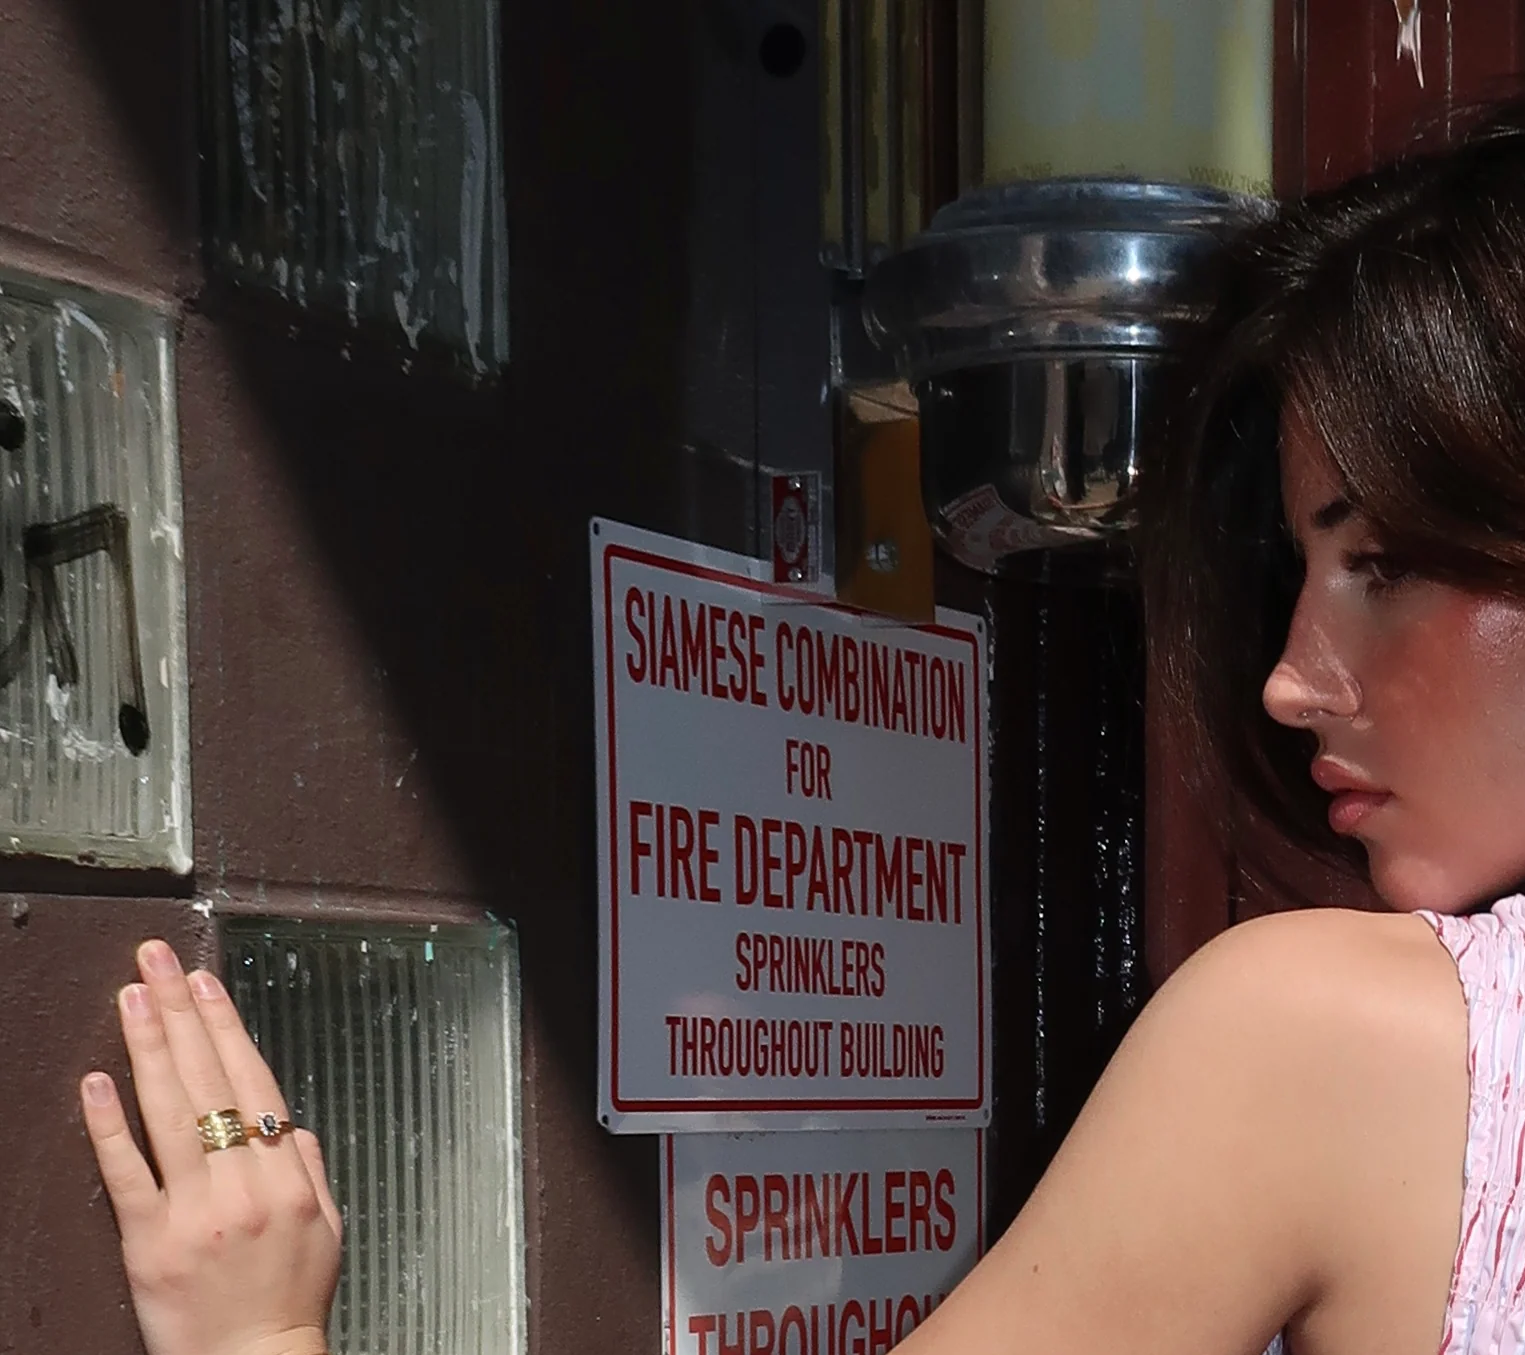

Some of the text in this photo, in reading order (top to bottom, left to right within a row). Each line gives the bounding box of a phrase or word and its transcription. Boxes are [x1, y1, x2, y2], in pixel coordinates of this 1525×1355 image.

[625, 586, 966, 744] SIAMESE COMBINATION
[786, 738, 832, 800] FOR
[629, 801, 966, 924] FIRE DEPARTMENT
[735, 932, 886, 998] SPRINKLERS
[665, 1016, 944, 1080] THROUGHOUT BUILDING
[704, 1168, 957, 1268] SPRINKLERS
